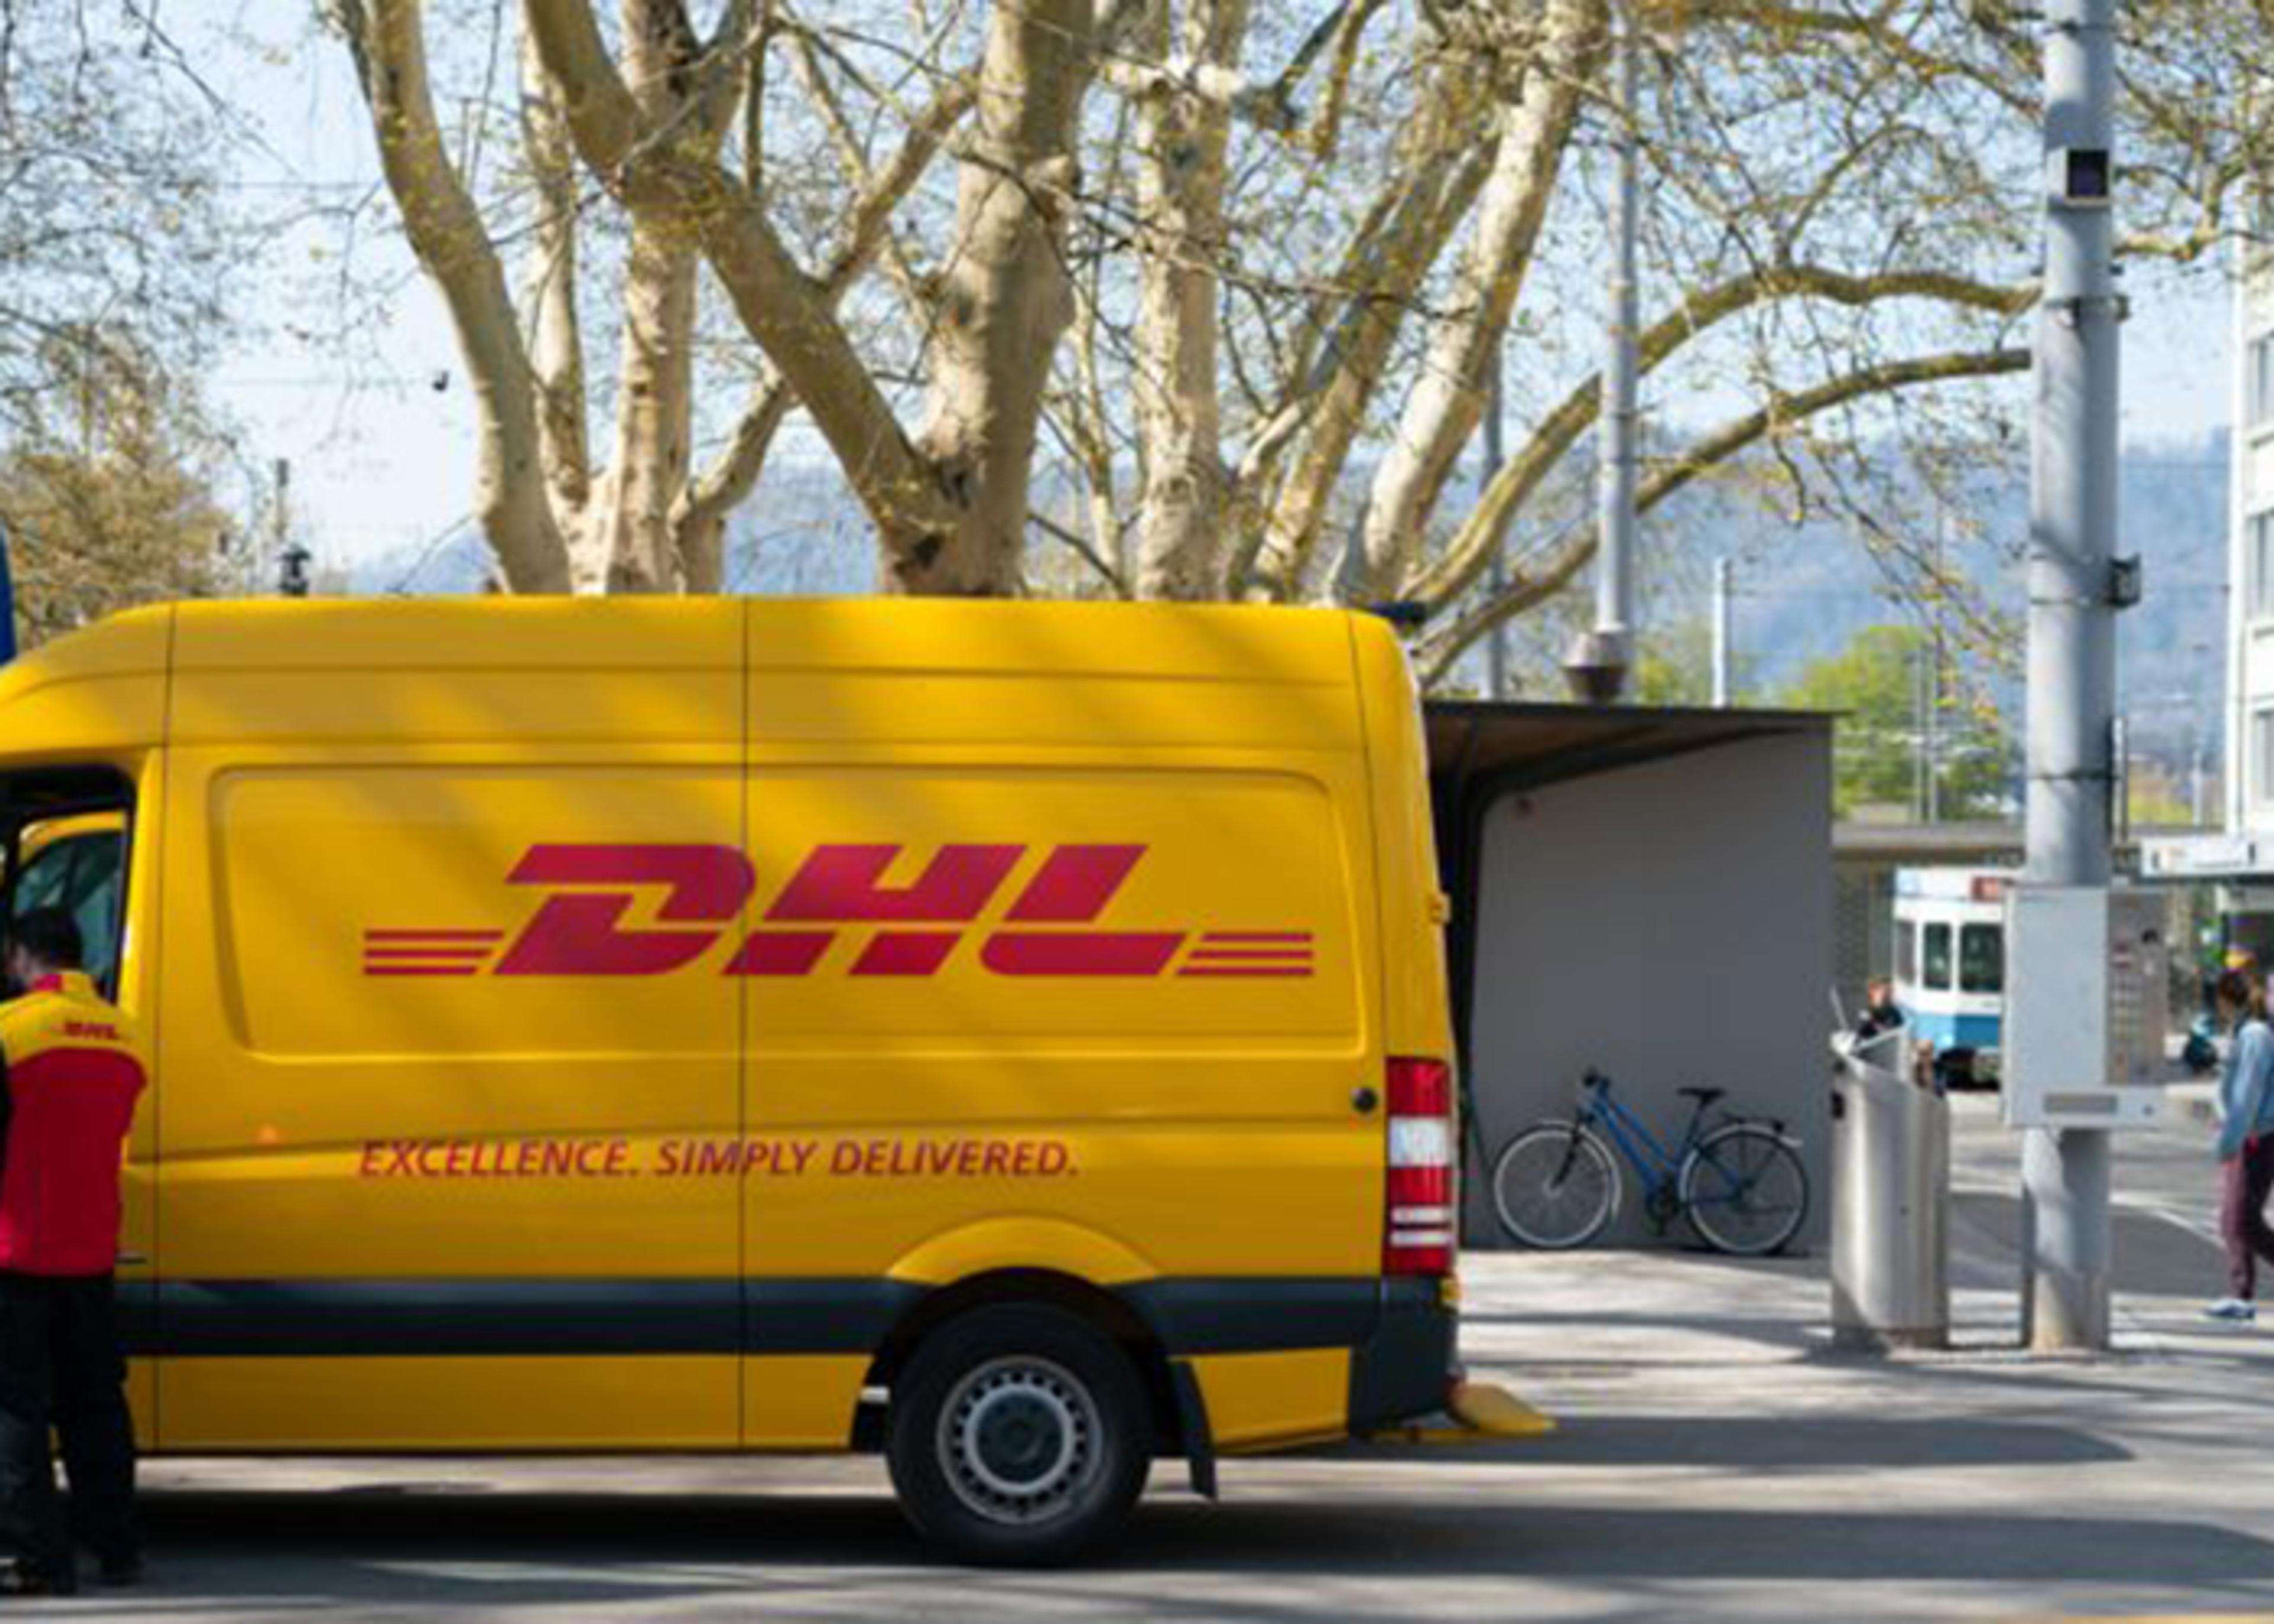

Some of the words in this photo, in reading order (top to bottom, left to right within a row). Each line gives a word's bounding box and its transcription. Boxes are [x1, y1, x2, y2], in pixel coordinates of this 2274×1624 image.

[493, 843, 1186, 977] DHL
[359, 1139, 638, 1177] EXCELLENCE.
[656, 1139, 817, 1177] SIMPLY
[830, 1139, 1077, 1177] DELIVERED.
